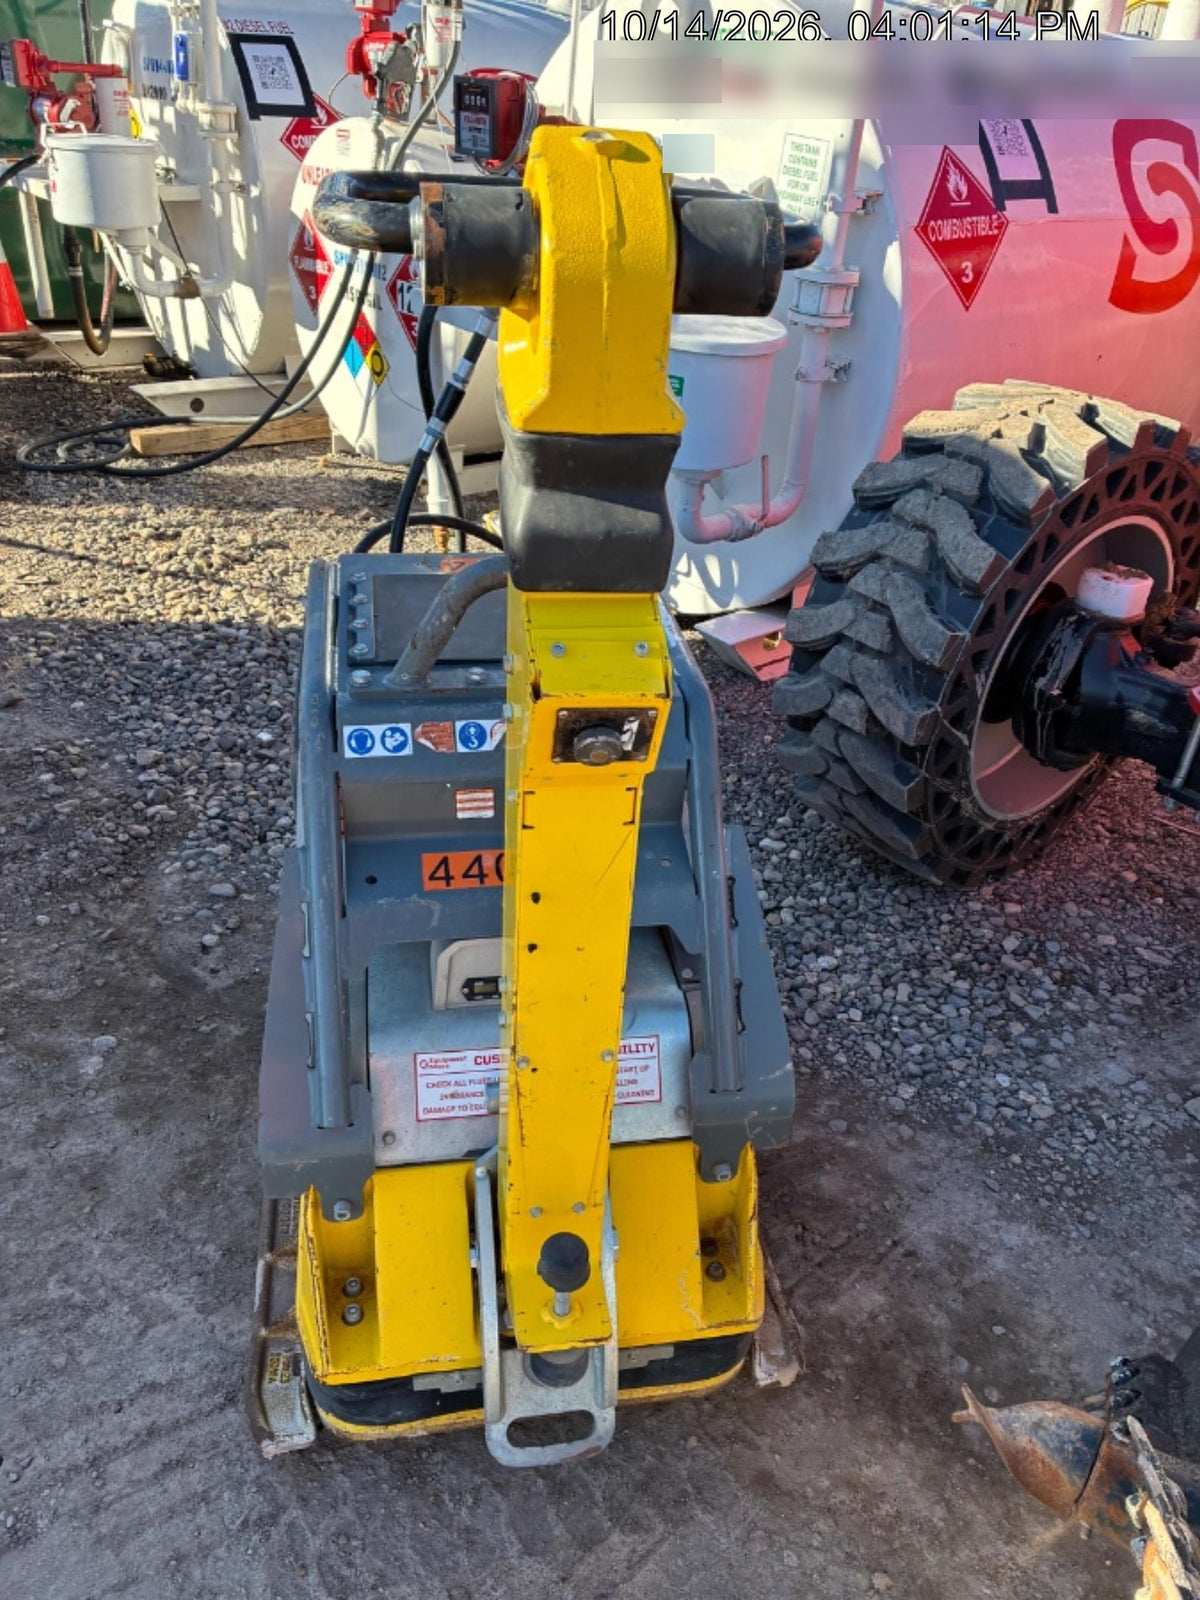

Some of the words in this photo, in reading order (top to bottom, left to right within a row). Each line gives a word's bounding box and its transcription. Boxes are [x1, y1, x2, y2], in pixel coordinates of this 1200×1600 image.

[928, 214, 1000, 242] COMBUSTIBLE
[961, 261, 974, 284] 3
[308, 285, 317, 300] 3
